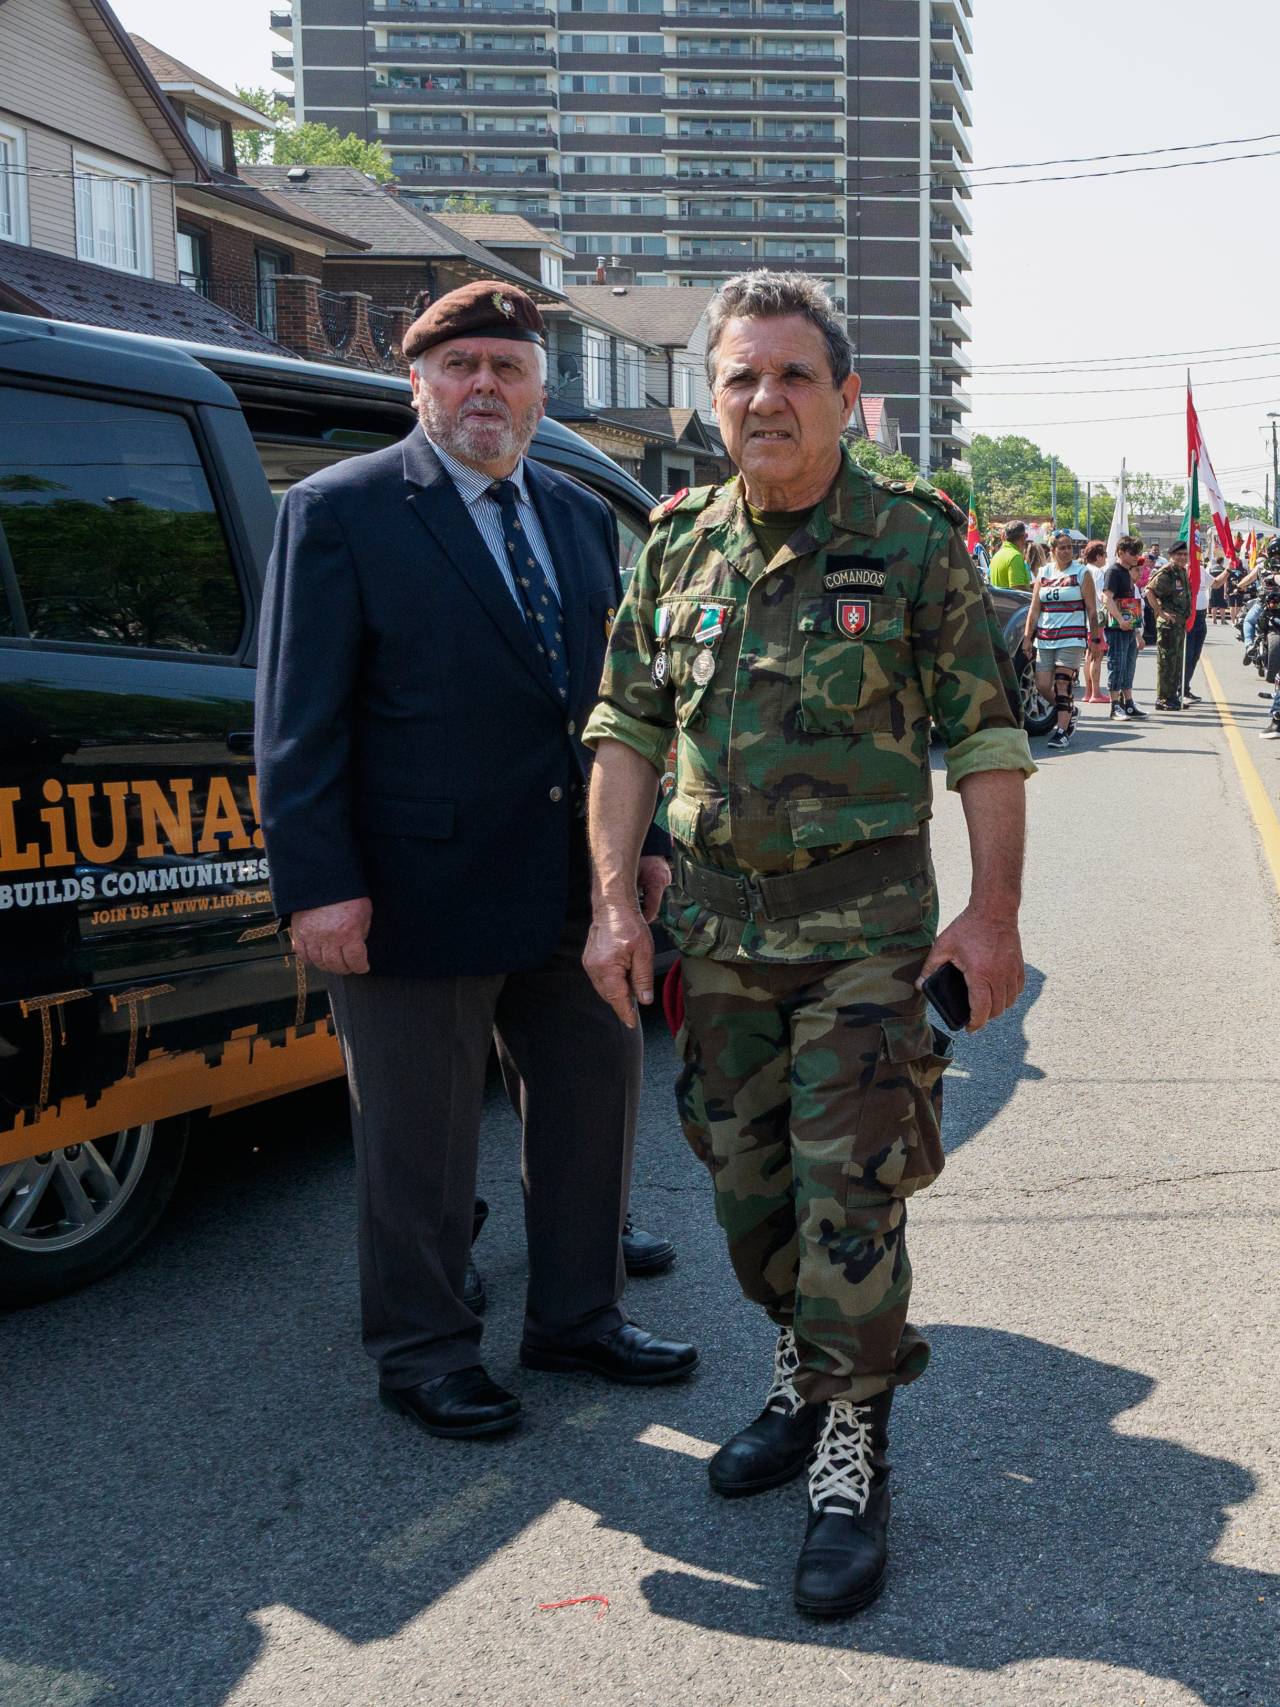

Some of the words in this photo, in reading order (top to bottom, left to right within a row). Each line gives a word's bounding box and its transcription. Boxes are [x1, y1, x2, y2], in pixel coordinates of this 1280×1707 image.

[826, 570, 885, 588] COMANDOS
[0, 876, 96, 910] BUILDS
[101, 858, 271, 898] COMMUNITIES
[91, 907, 128, 925] JOIN
[131, 904, 149, 920] US
[151, 902, 170, 918] AT
[172, 890, 272, 914] WWW.LIUNA.CA
